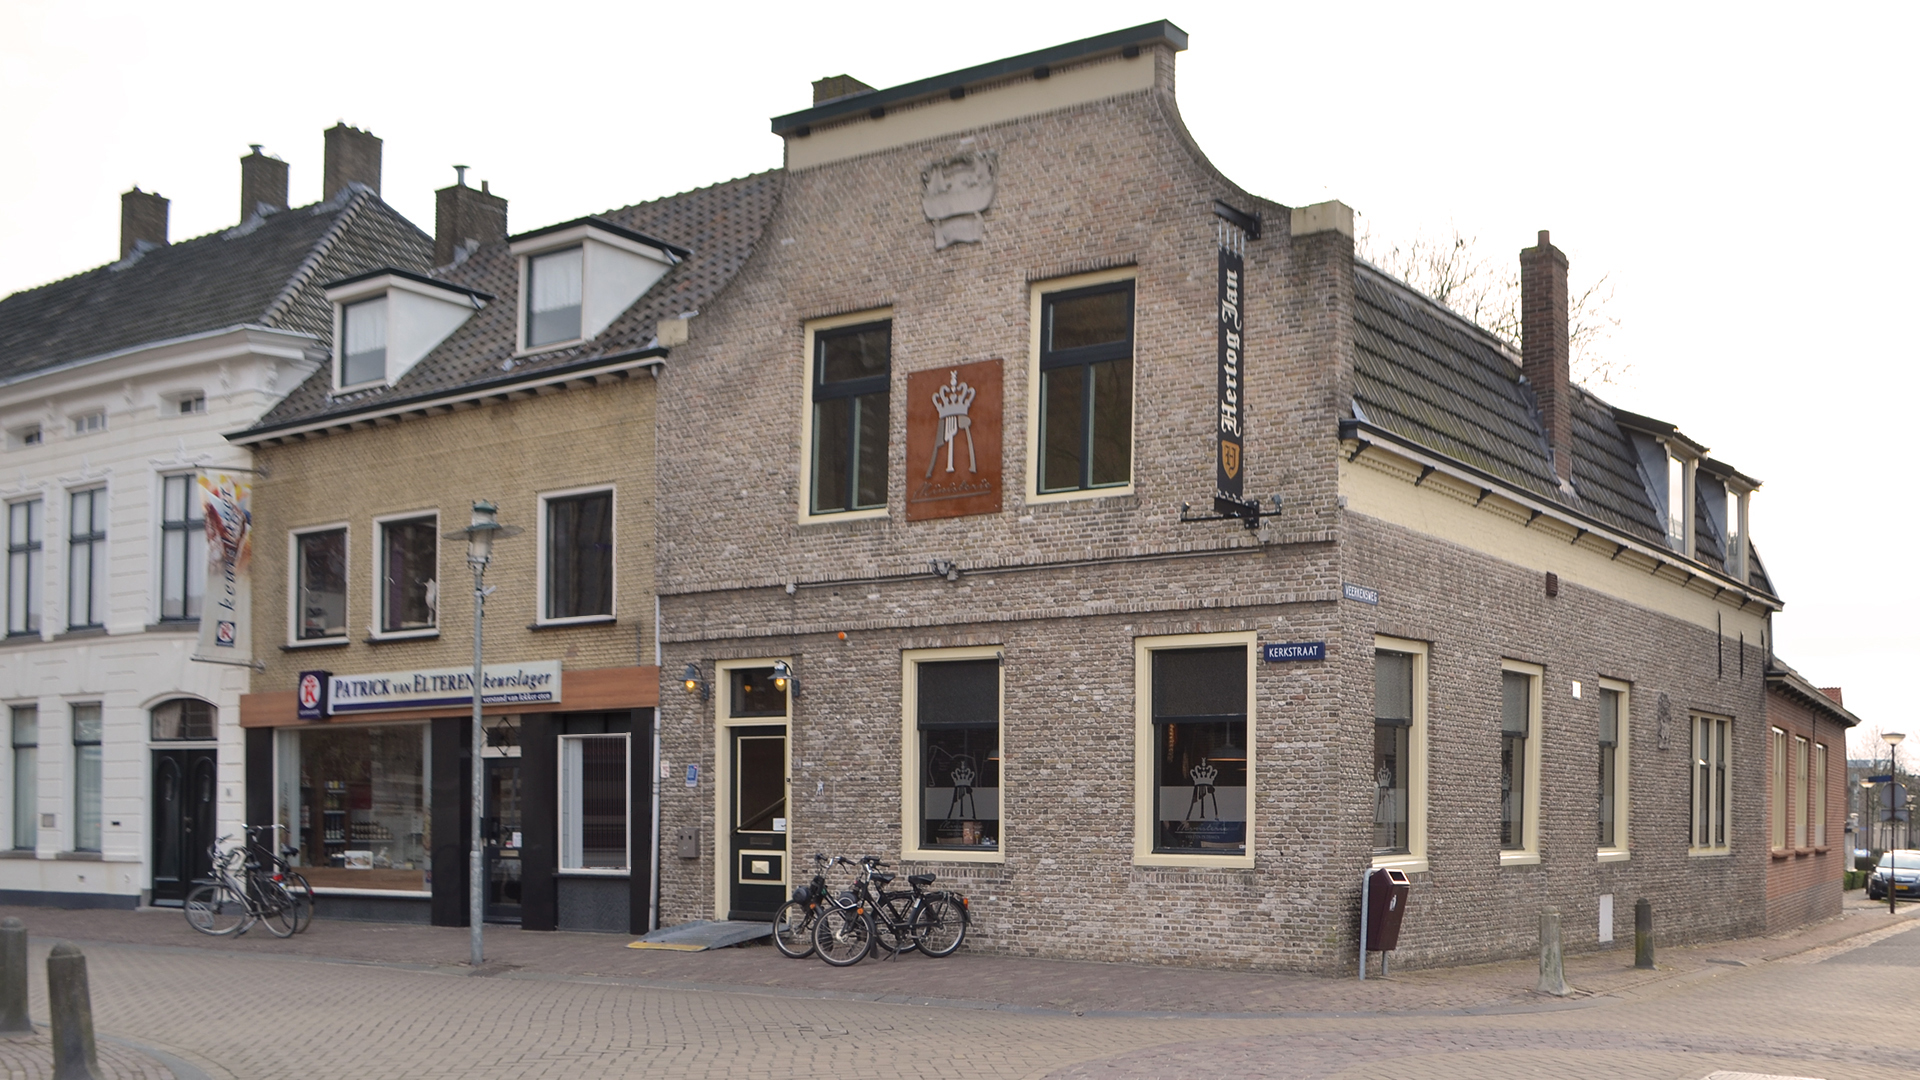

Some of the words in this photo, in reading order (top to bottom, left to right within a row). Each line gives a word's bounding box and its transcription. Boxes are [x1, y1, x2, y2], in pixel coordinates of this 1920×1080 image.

[1221, 268, 1242, 332] Jan
[1220, 328, 1241, 438] Hertog
[217, 486, 238, 612] keurslager
[1269, 645, 1318, 658] KERKSTRAAT
[334, 678, 390, 699] PATRICK
[392, 682, 411, 695] VAN
[413, 672, 475, 694] ELTEREN
[482, 669, 551, 690] keurslager
